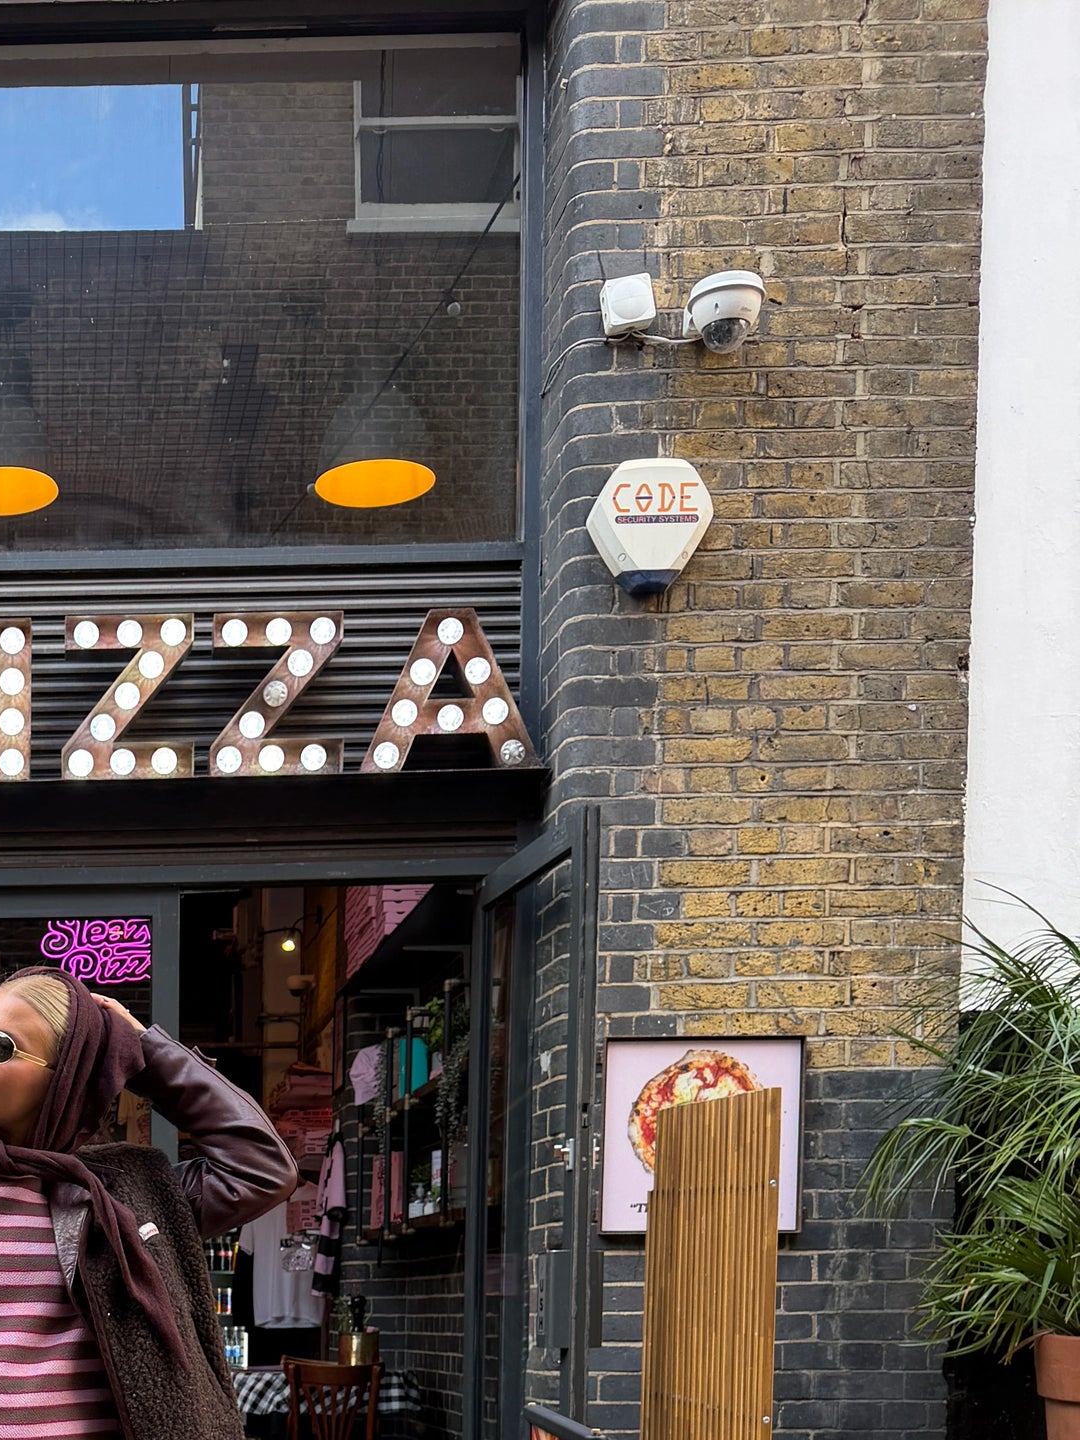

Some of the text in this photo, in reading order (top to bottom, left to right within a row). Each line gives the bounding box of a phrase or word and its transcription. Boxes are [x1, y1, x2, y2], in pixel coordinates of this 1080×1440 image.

[612, 482, 699, 513] CODE
[658, 515, 698, 523] SYSTEMS
[41, 919, 151, 958] Sleaz
[61, 947, 151, 984] Pizz
